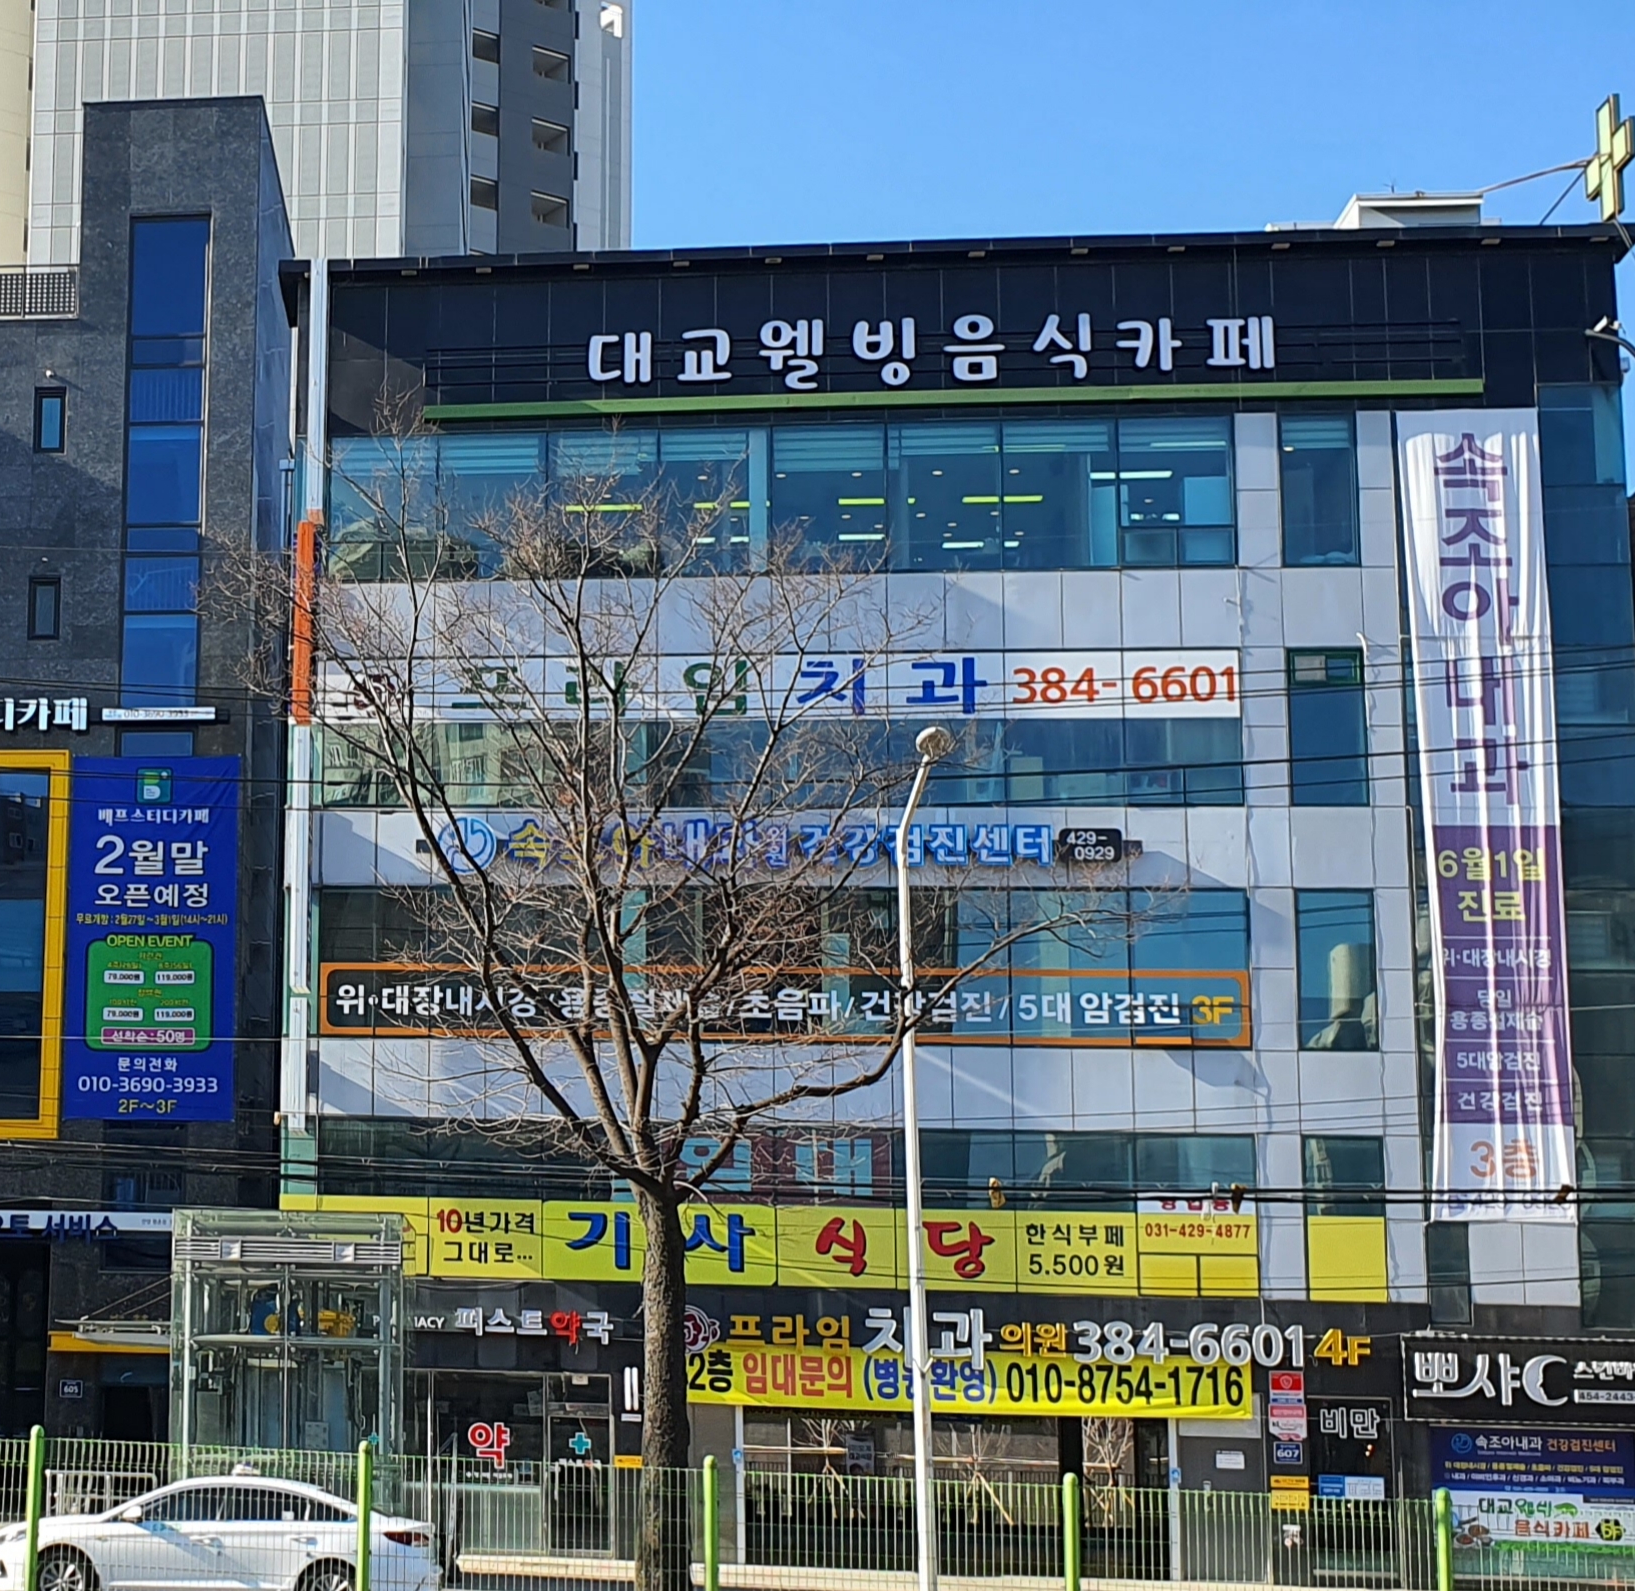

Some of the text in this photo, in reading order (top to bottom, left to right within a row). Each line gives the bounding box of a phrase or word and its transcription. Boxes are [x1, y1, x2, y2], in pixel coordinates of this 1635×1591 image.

[587, 313, 1276, 390] 대교웰빙음식카페
[1433, 432, 1530, 806] 속조아내과
[796, 657, 988, 716] 치과
[1013, 665, 1237, 705] 384-6601
[98, 807, 210, 827] 베프스터디카페
[95, 835, 208, 877] 2월말
[1074, 847, 1115, 861] 0929
[1437, 847, 1546, 882] 6월1일
[94, 883, 209, 908] 오픈예정
[1456, 890, 1526, 923] 진료
[106, 934, 193, 947] OPEN EVENT
[740, 989, 842, 1022] 초음파
[1018, 992, 1071, 1023] 5대
[1080, 991, 1181, 1026] 암검진
[1191, 995, 1235, 1025] 3F
[1476, 988, 1512, 1008] 당일
[117, 1058, 178, 1073] 문의전화
[77, 1077, 219, 1094] 010-3690-3933
[1457, 1090, 1543, 1112] 건강검진
[1469, 1138, 1540, 1180] 3층
[41, 1213, 120, 1243] 서비스
[437, 1208, 536, 1234] 10년가격
[1026, 1223, 1125, 1249] 한식부페
[1145, 1222, 1251, 1240] 031-429-4877
[568, 1211, 995, 1279] 기사 식당
[455, 1307, 614, 1346] 퍼스트약국
[726, 1306, 1371, 1371] 프라임 치과 의원 384-6601 4F
[688, 1349, 733, 1393] 2층
[743, 1352, 853, 1399] 임대문의
[1006, 1361, 1244, 1407] 010-8754-1716
[1320, 1406, 1380, 1440] 비만
[468, 1421, 511, 1470] 약
[1276, 1448, 1301, 1458] 607
[1474, 1434, 1617, 1453] 속조아내과 건강검진센터
